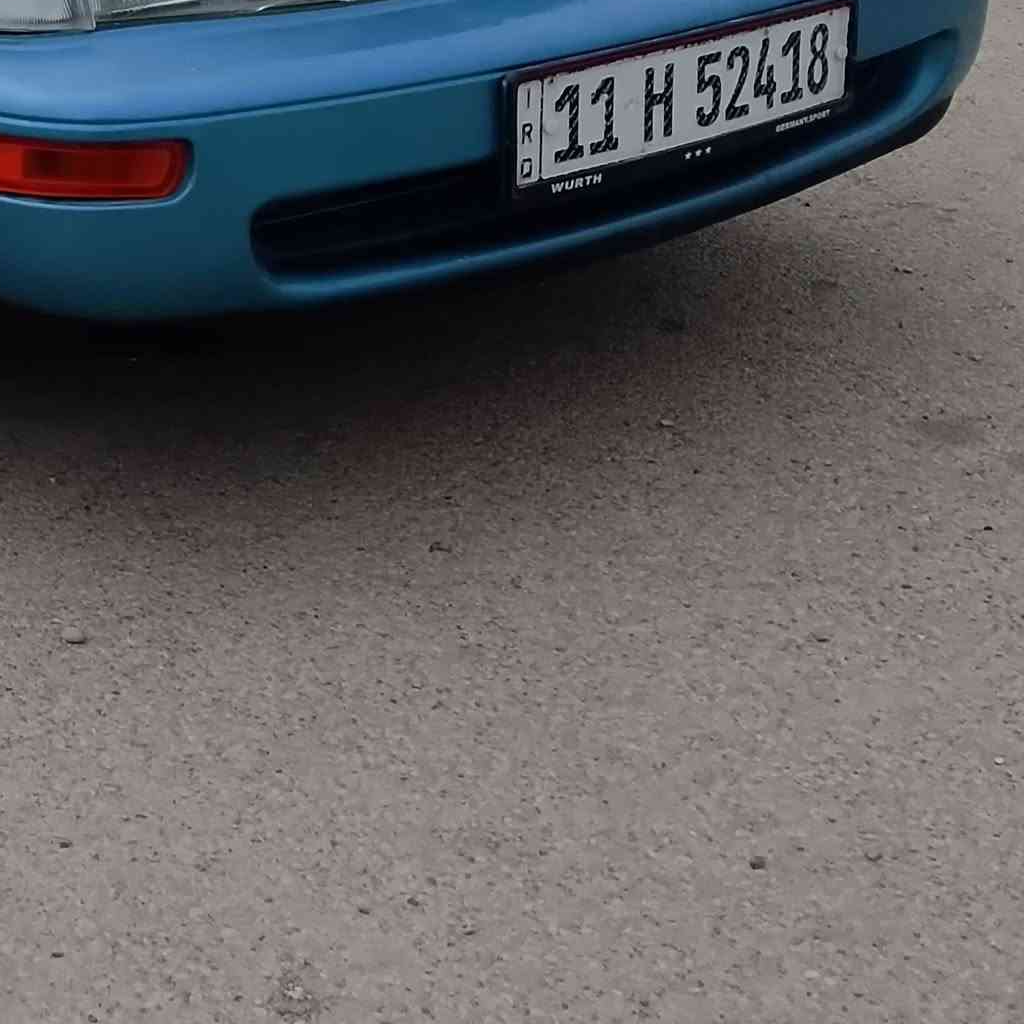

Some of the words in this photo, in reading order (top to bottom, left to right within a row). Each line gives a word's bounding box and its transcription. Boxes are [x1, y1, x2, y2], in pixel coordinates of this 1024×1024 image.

[554, 77, 619, 164] 11
[644, 63, 675, 143] H
[696, 23, 829, 127] 52418
[551, 173, 603, 194] WURTH
